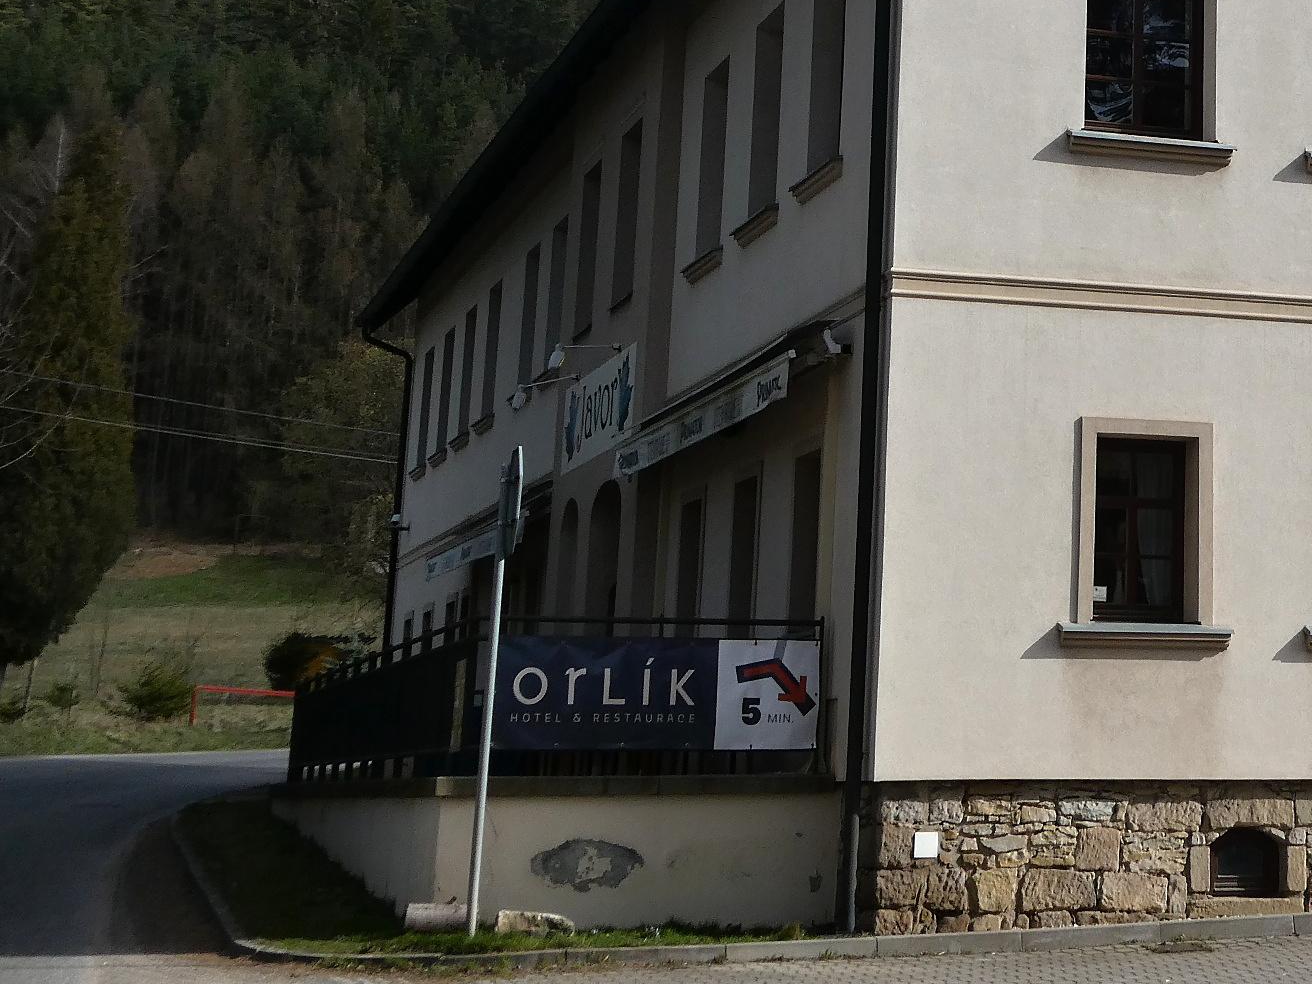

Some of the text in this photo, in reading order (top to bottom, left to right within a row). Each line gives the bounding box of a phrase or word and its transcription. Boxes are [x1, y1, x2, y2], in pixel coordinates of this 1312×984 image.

[576, 376, 619, 453] Javor
[509, 712, 696, 724] HOTEL & RESTAURACE
[740, 697, 795, 726] 5 MIN.
